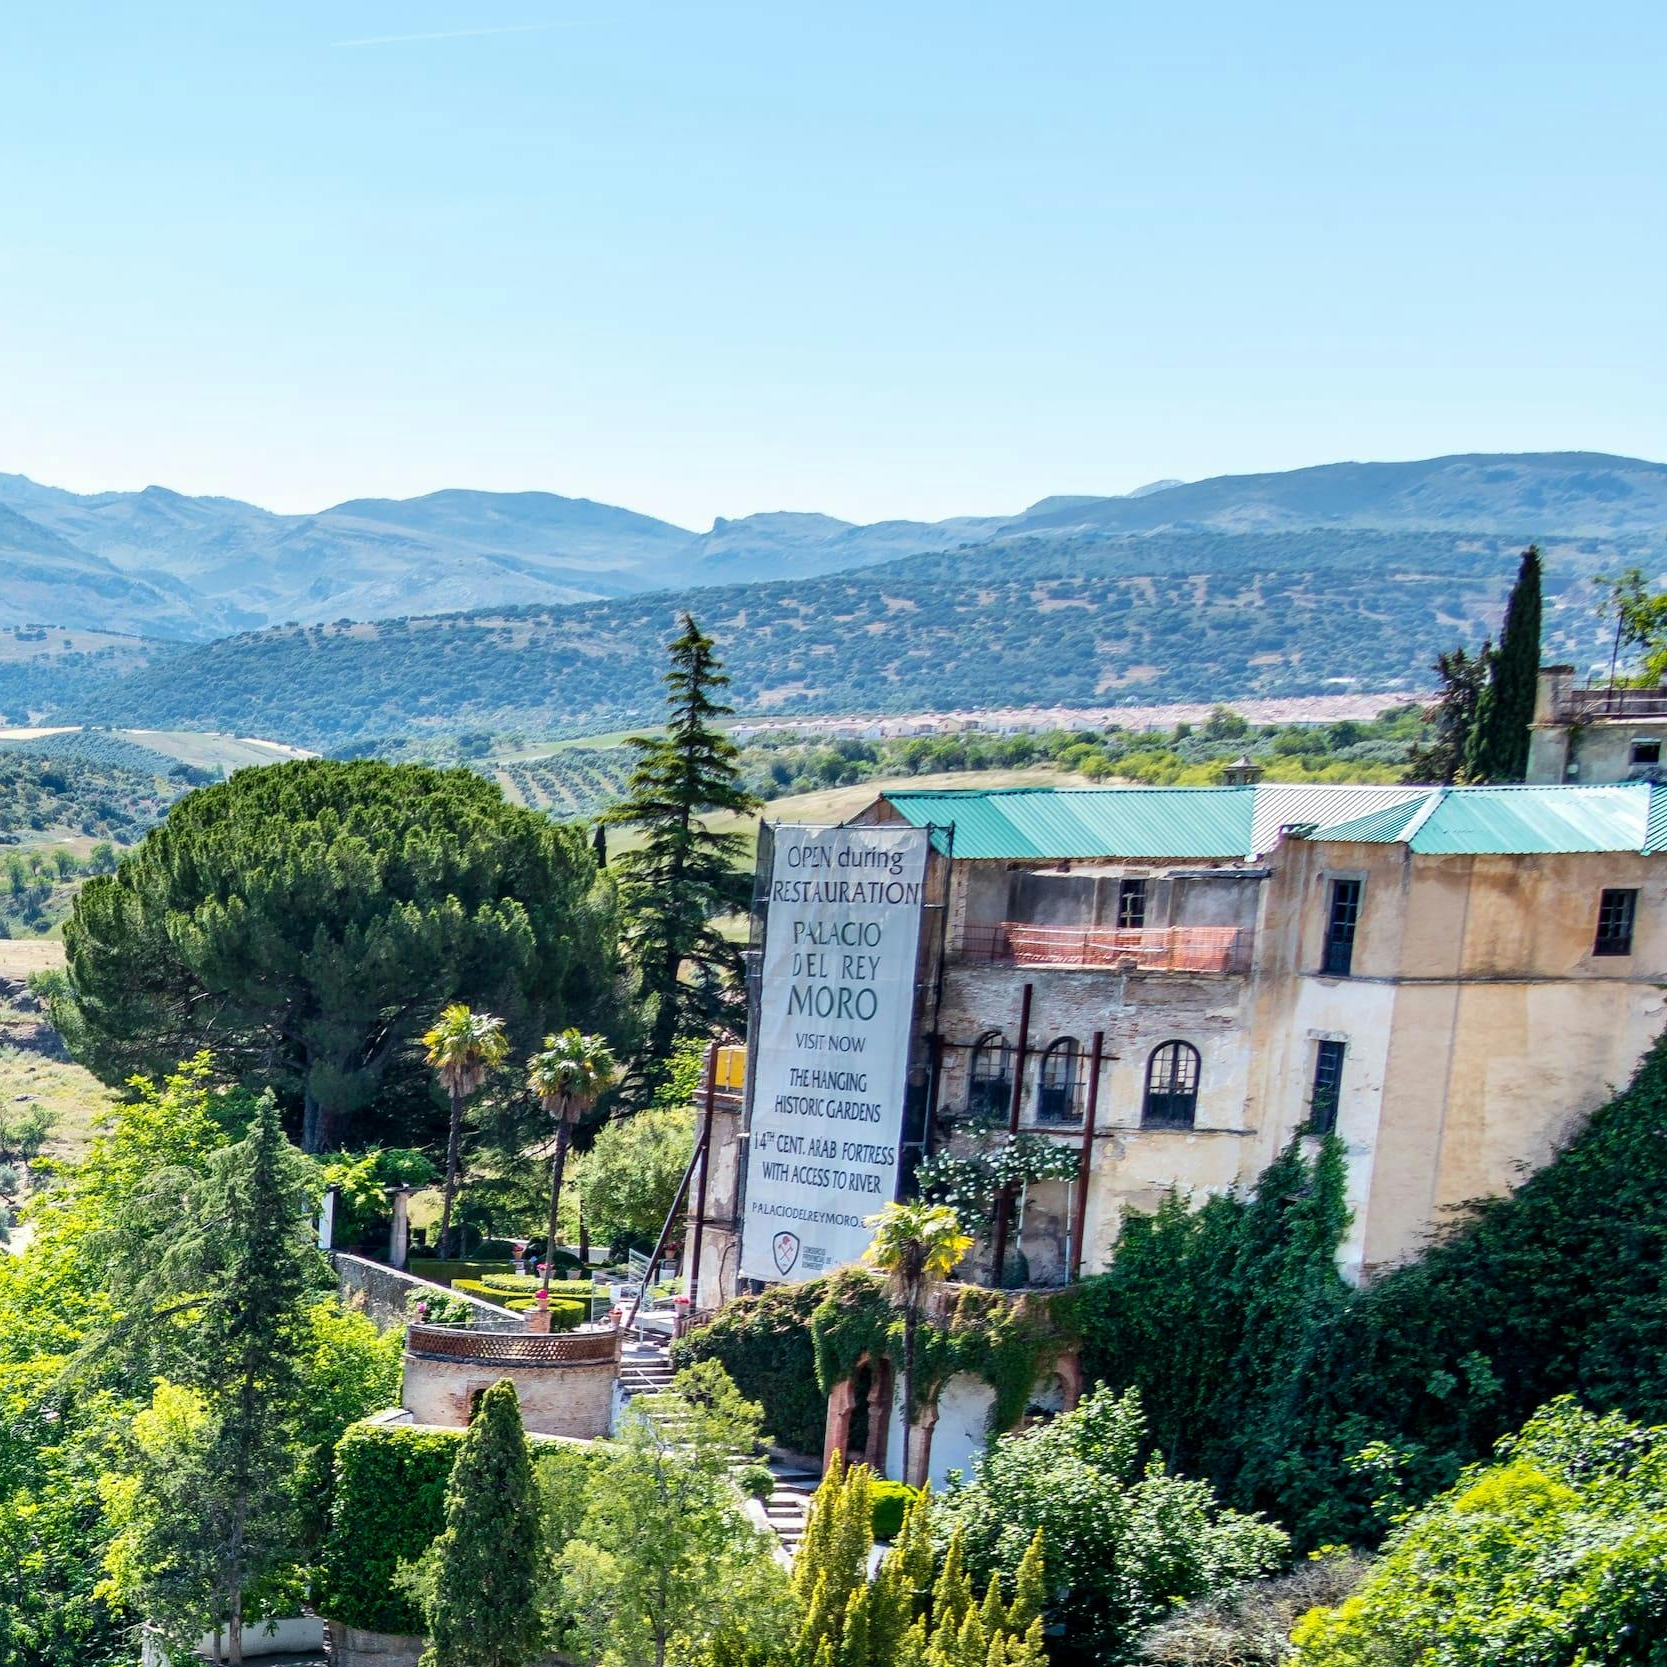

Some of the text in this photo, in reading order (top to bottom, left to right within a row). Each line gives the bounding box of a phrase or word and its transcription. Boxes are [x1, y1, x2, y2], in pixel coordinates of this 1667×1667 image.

[788, 846, 905, 875] OPEN during
[773, 880, 920, 905] RESTAURATION
[793, 921, 882, 947] PALACIO
[793, 953, 881, 980] DEL REY
[787, 985, 878, 1021] MORO
[796, 1033, 866, 1053] VISIT NOW
[790, 1068, 867, 1093] THE HANGING
[775, 1095, 881, 1123] HISTORIC GARDENS
[755, 1132, 895, 1166] 14TH CENT. ARAB FORTRESS
[763, 1161, 882, 1194] WITH ACCESS TO RIVER
